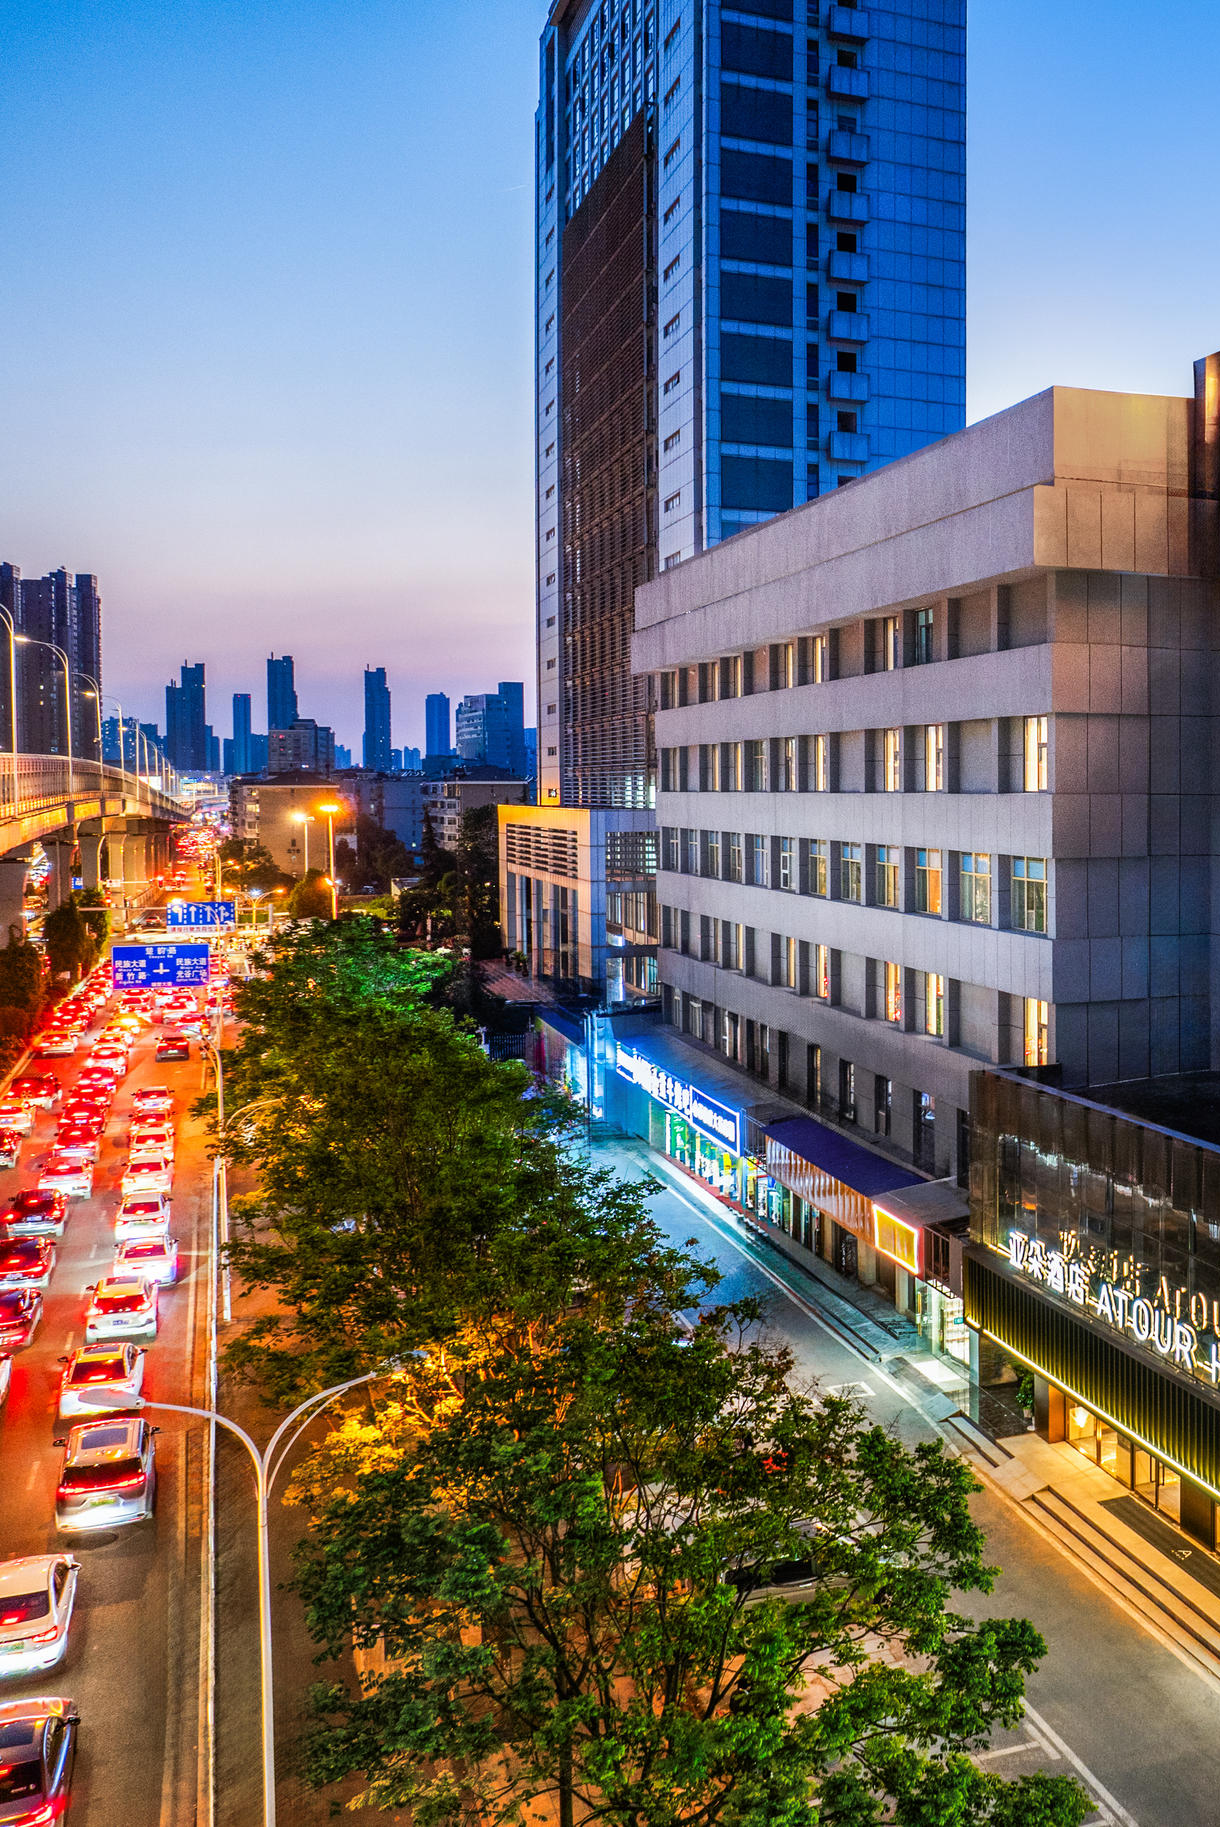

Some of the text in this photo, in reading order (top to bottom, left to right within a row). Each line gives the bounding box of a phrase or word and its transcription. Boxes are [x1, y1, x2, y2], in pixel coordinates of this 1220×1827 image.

[115, 960, 146, 968] 民族大道
[176, 958, 206, 966] 民族大道
[1008, 1231, 1088, 1306] 亚朵酒店
[1097, 1283, 1198, 1371] ATOUR
